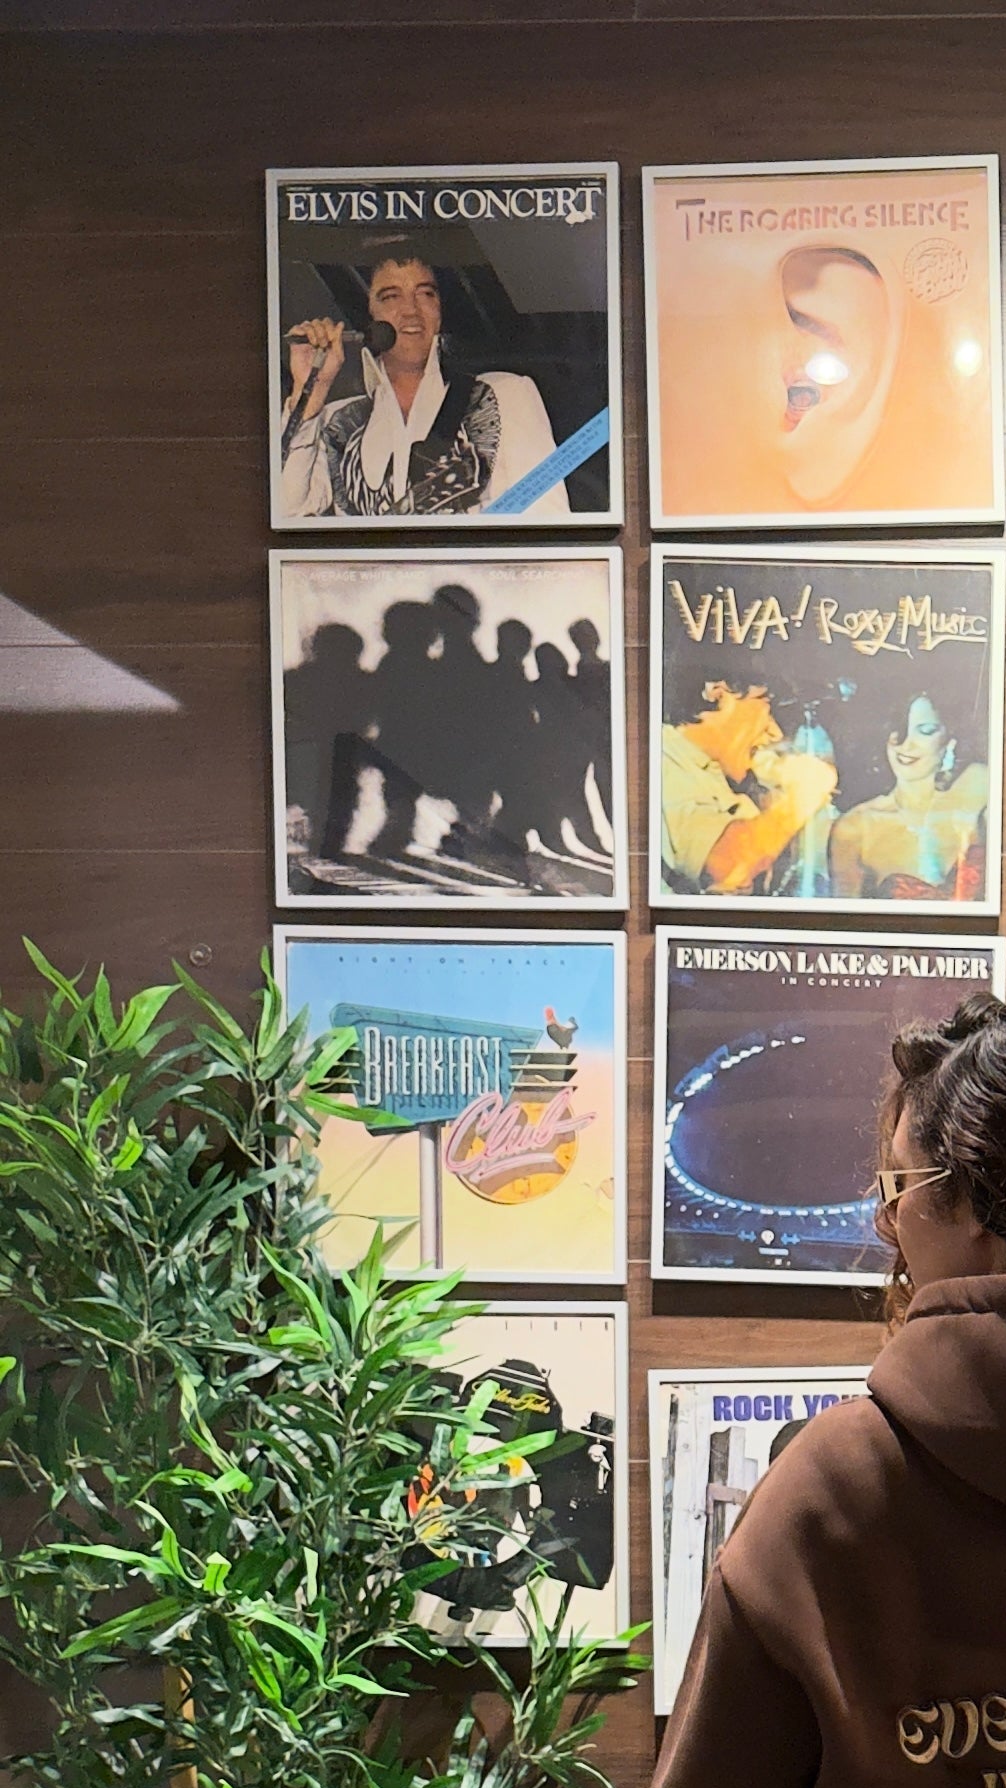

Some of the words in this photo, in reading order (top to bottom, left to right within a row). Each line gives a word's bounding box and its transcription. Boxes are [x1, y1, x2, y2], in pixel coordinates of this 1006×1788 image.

[286, 189, 377, 222] ELVIS
[385, 189, 425, 220] IN
[434, 187, 603, 219] CONCERT
[676, 199, 733, 241] THE
[740, 205, 857, 232] ROARING
[864, 201, 969, 231] SILENCE
[812, 598, 911, 657] Roxy
[898, 595, 989, 650] Music
[676, 947, 792, 973] EMERSON
[797, 951, 865, 975] LAKE
[866, 953, 889, 976] &
[892, 955, 989, 979] PALMER
[781, 977, 798, 985] IN
[807, 977, 883, 989] CONCERT
[364, 1026, 503, 1106] BREAKFAST
[443, 1087, 598, 1174] Club
[713, 1394, 794, 1422] ROCK
